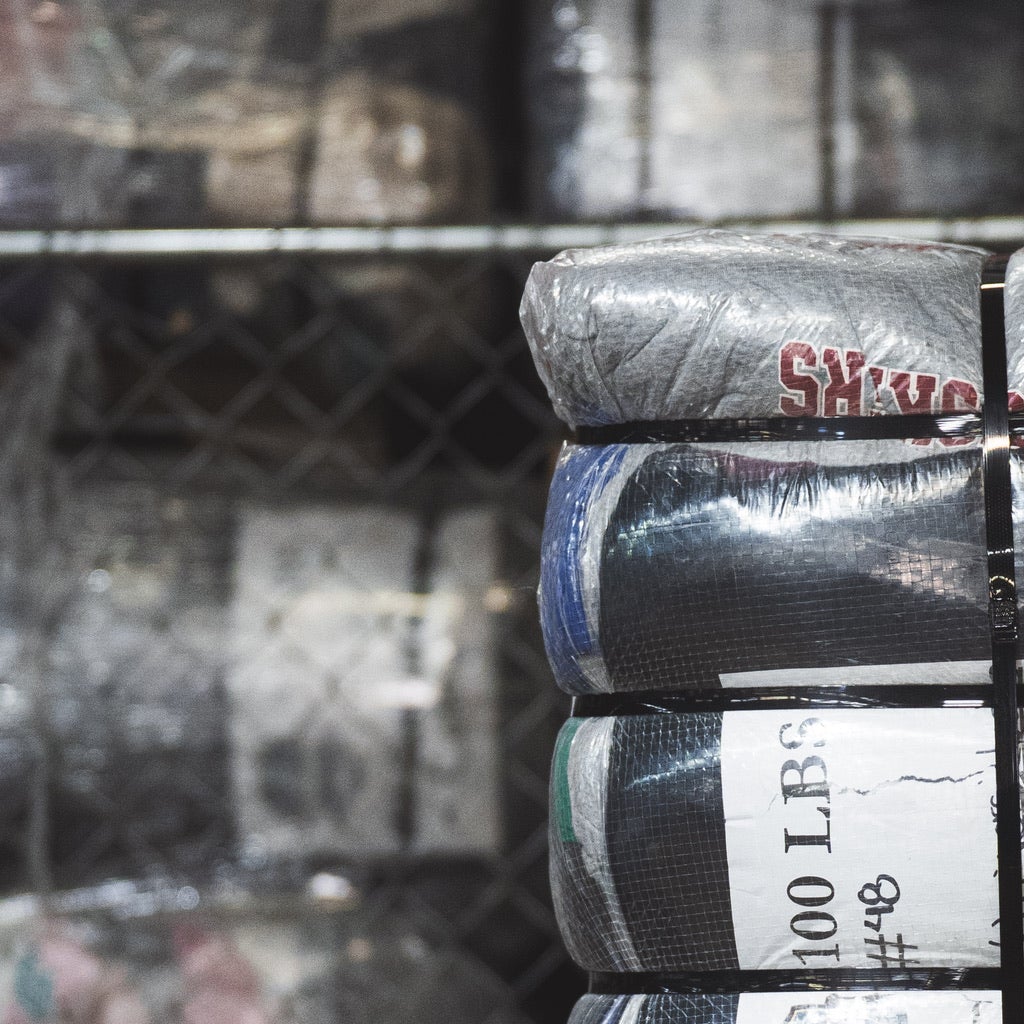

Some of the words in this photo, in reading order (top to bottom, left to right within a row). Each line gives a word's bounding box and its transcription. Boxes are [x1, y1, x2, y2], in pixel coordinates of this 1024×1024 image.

[779, 718, 832, 853] LBS
[786, 876, 840, 966] 100
[858, 874, 920, 967] #48
